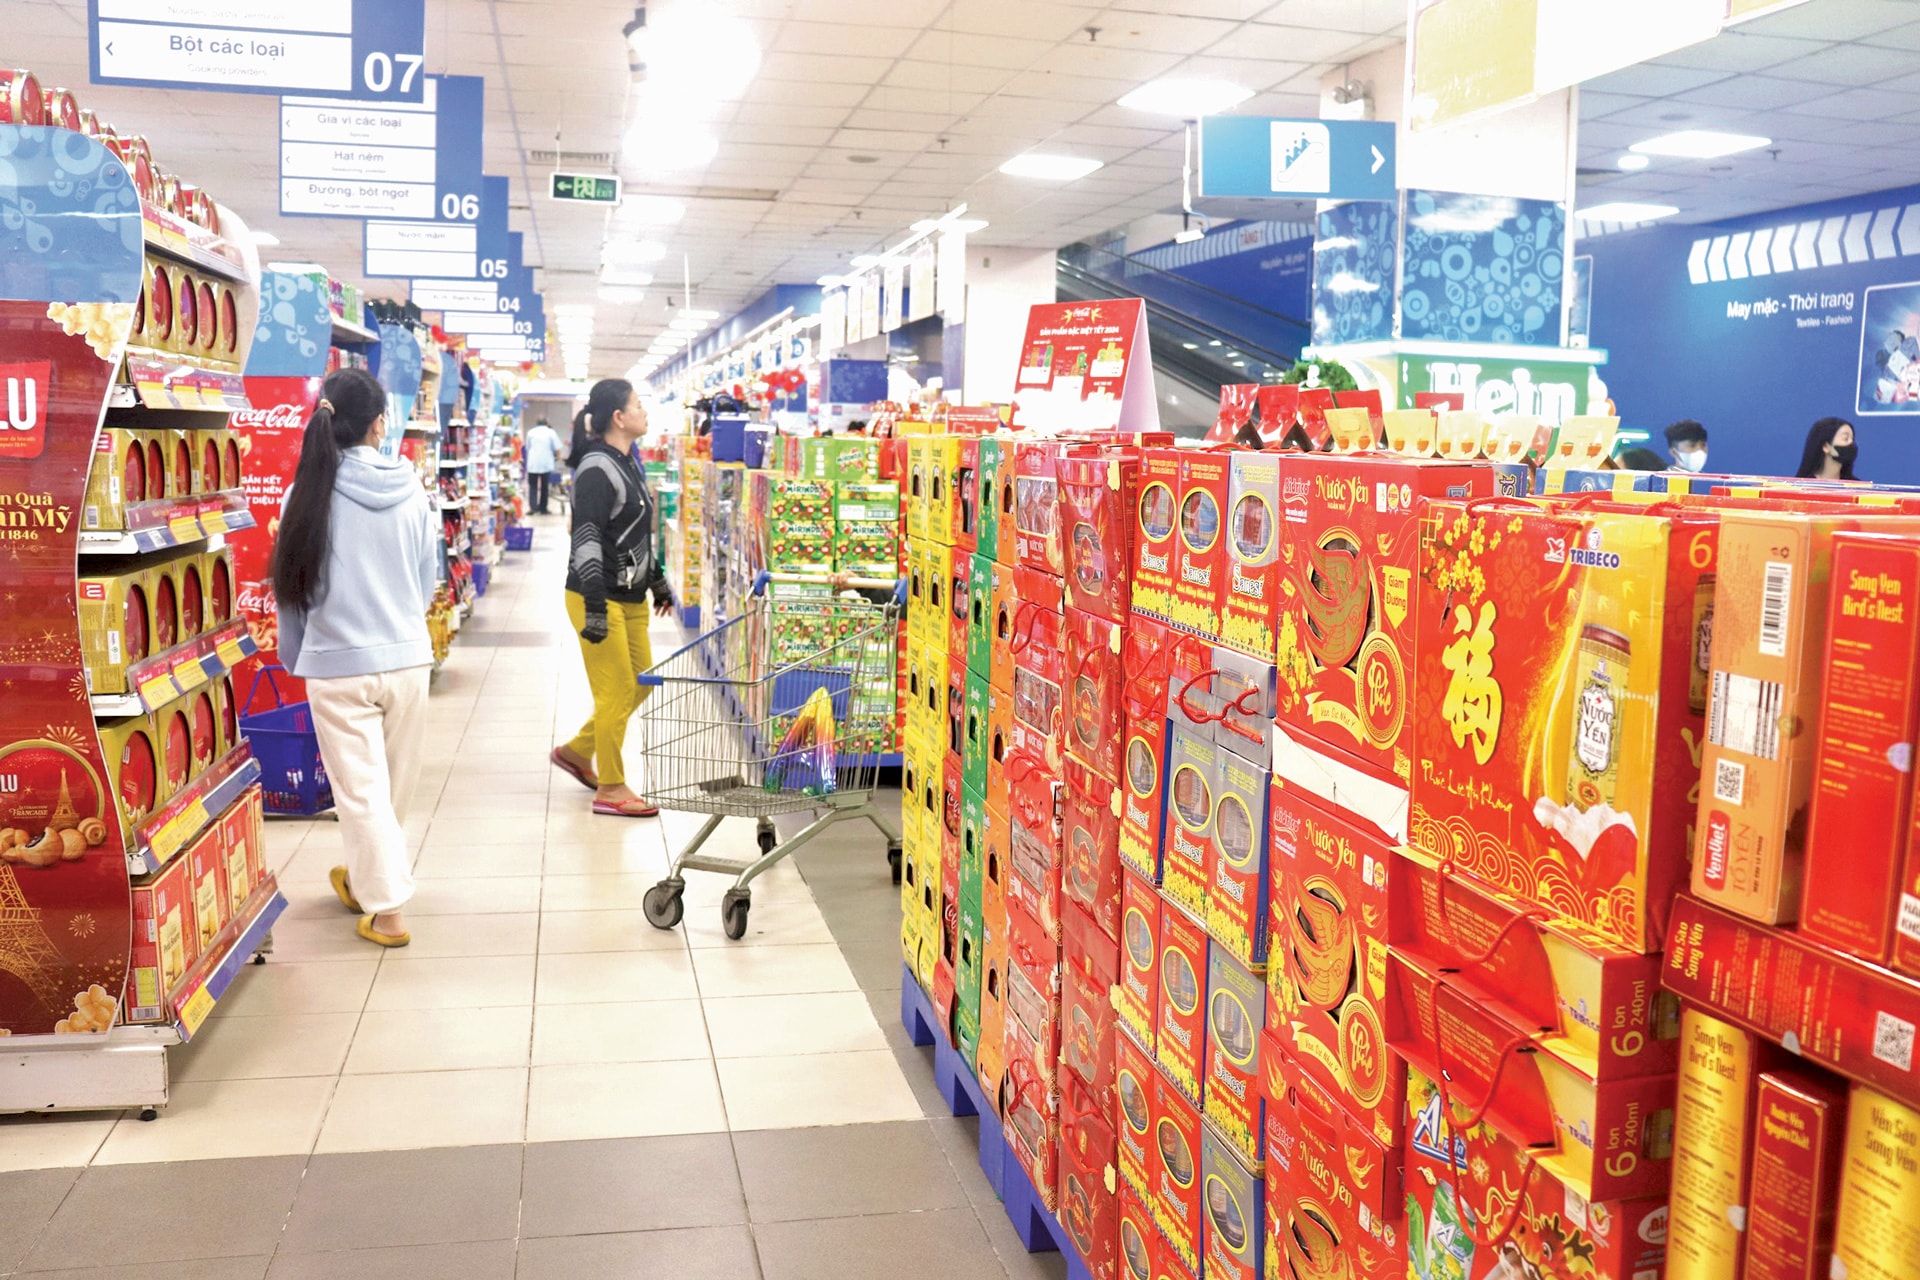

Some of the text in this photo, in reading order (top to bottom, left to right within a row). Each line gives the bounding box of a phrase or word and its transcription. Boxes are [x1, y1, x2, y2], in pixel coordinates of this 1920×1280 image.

[170, 35, 286, 61] Bột các loại
[363, 51, 424, 93] 07
[442, 193, 480, 220] 06
[480, 259, 508, 278] 05
[498, 297, 520, 312] 04
[1727, 301, 1751, 320] May
[1753, 298, 1779, 318] mặc
[1789, 293, 1817, 311] Thời
[1821, 292, 1854, 310] trang
[514, 322, 533, 334] 03
[526, 339, 542, 349] 02
[231, 404, 306, 428] Coca-Cola
[263, 473, 282, 485] KẾT
[263, 483, 282, 495] NÊN
[1315, 475, 1346, 501] Nước
[15, 491, 53, 507] Quà
[32, 506, 73, 533] Mỹ
[8, 530, 39, 540] 1846
[1570, 549, 1620, 568] TRIBECO
[1689, 530, 1712, 568] 6
[1850, 569, 1901, 598] Song Yen
[1842, 595, 1904, 624] Bird's Nest
[1630, 980, 1645, 1026] 240ml
[1611, 1005, 1644, 1057] 6 lon
[1624, 1102, 1639, 1147] 240ml
[1605, 1127, 1637, 1178] 6 lon
